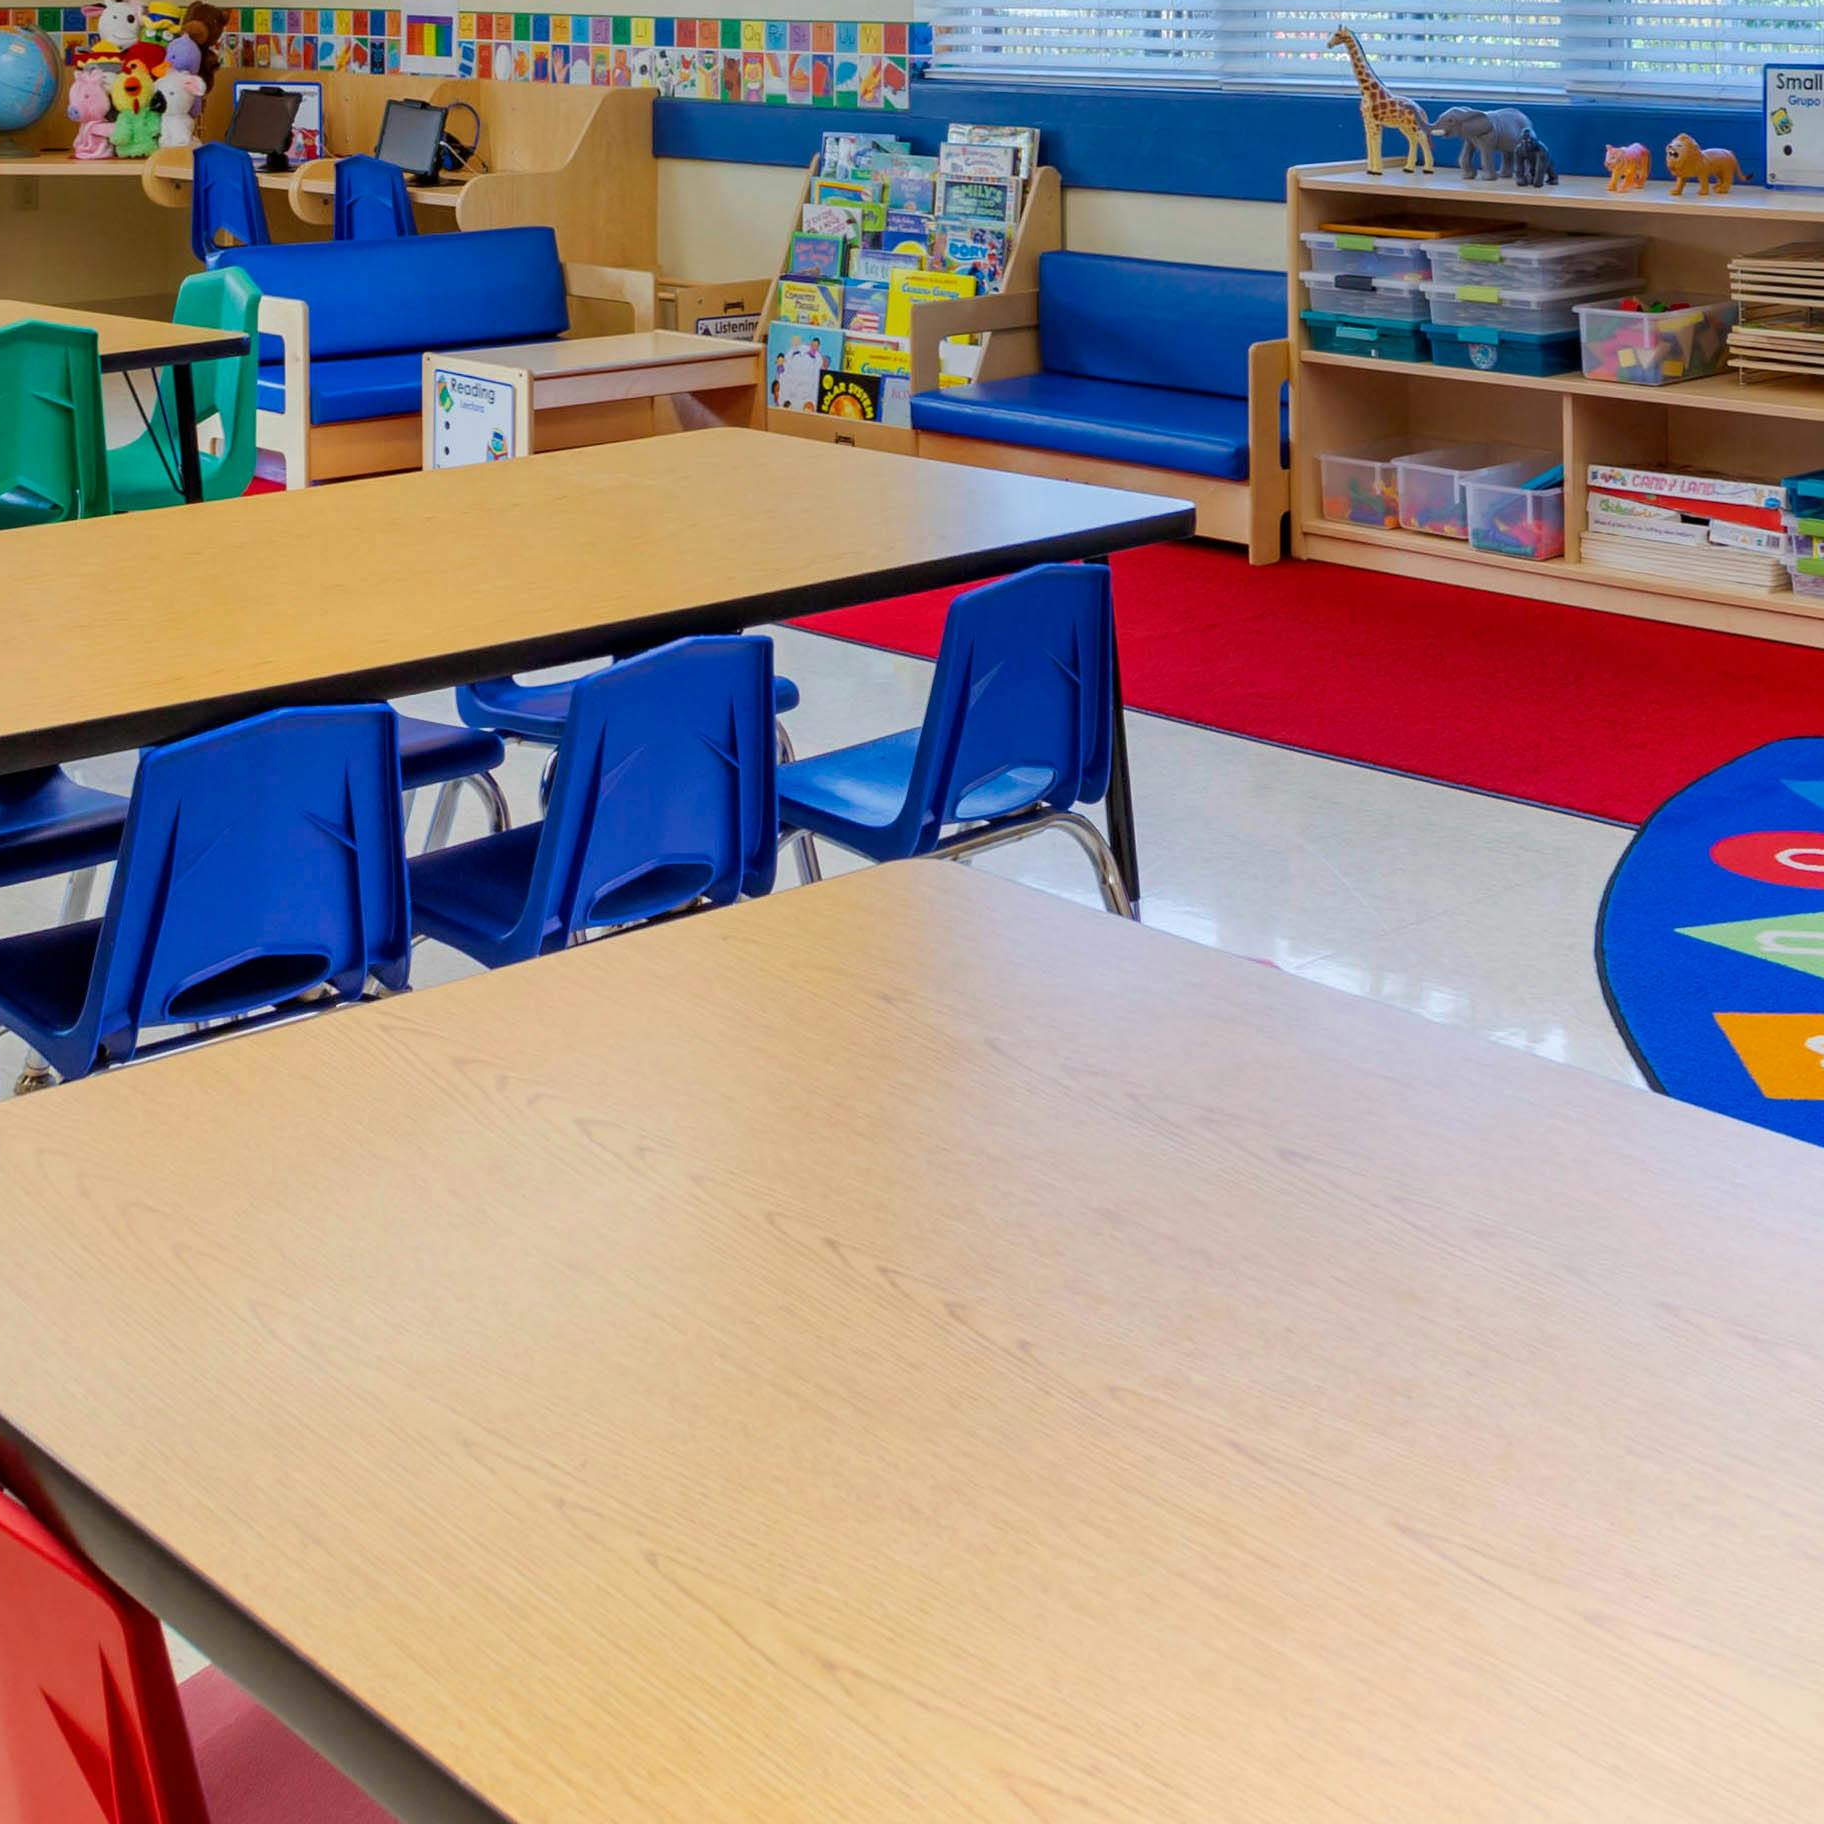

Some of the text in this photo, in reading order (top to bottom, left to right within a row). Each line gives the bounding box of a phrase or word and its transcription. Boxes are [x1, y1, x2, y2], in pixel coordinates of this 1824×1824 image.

[1776, 72, 1823, 92] Small
[1787, 94, 1821, 108] Grupo
[948, 242, 988, 259] DORY
[451, 377, 496, 406] Reading
[848, 382, 875, 420] SYSTEM
[1631, 474, 1678, 493] CANDY
[1679, 480, 1717, 497] LAND
